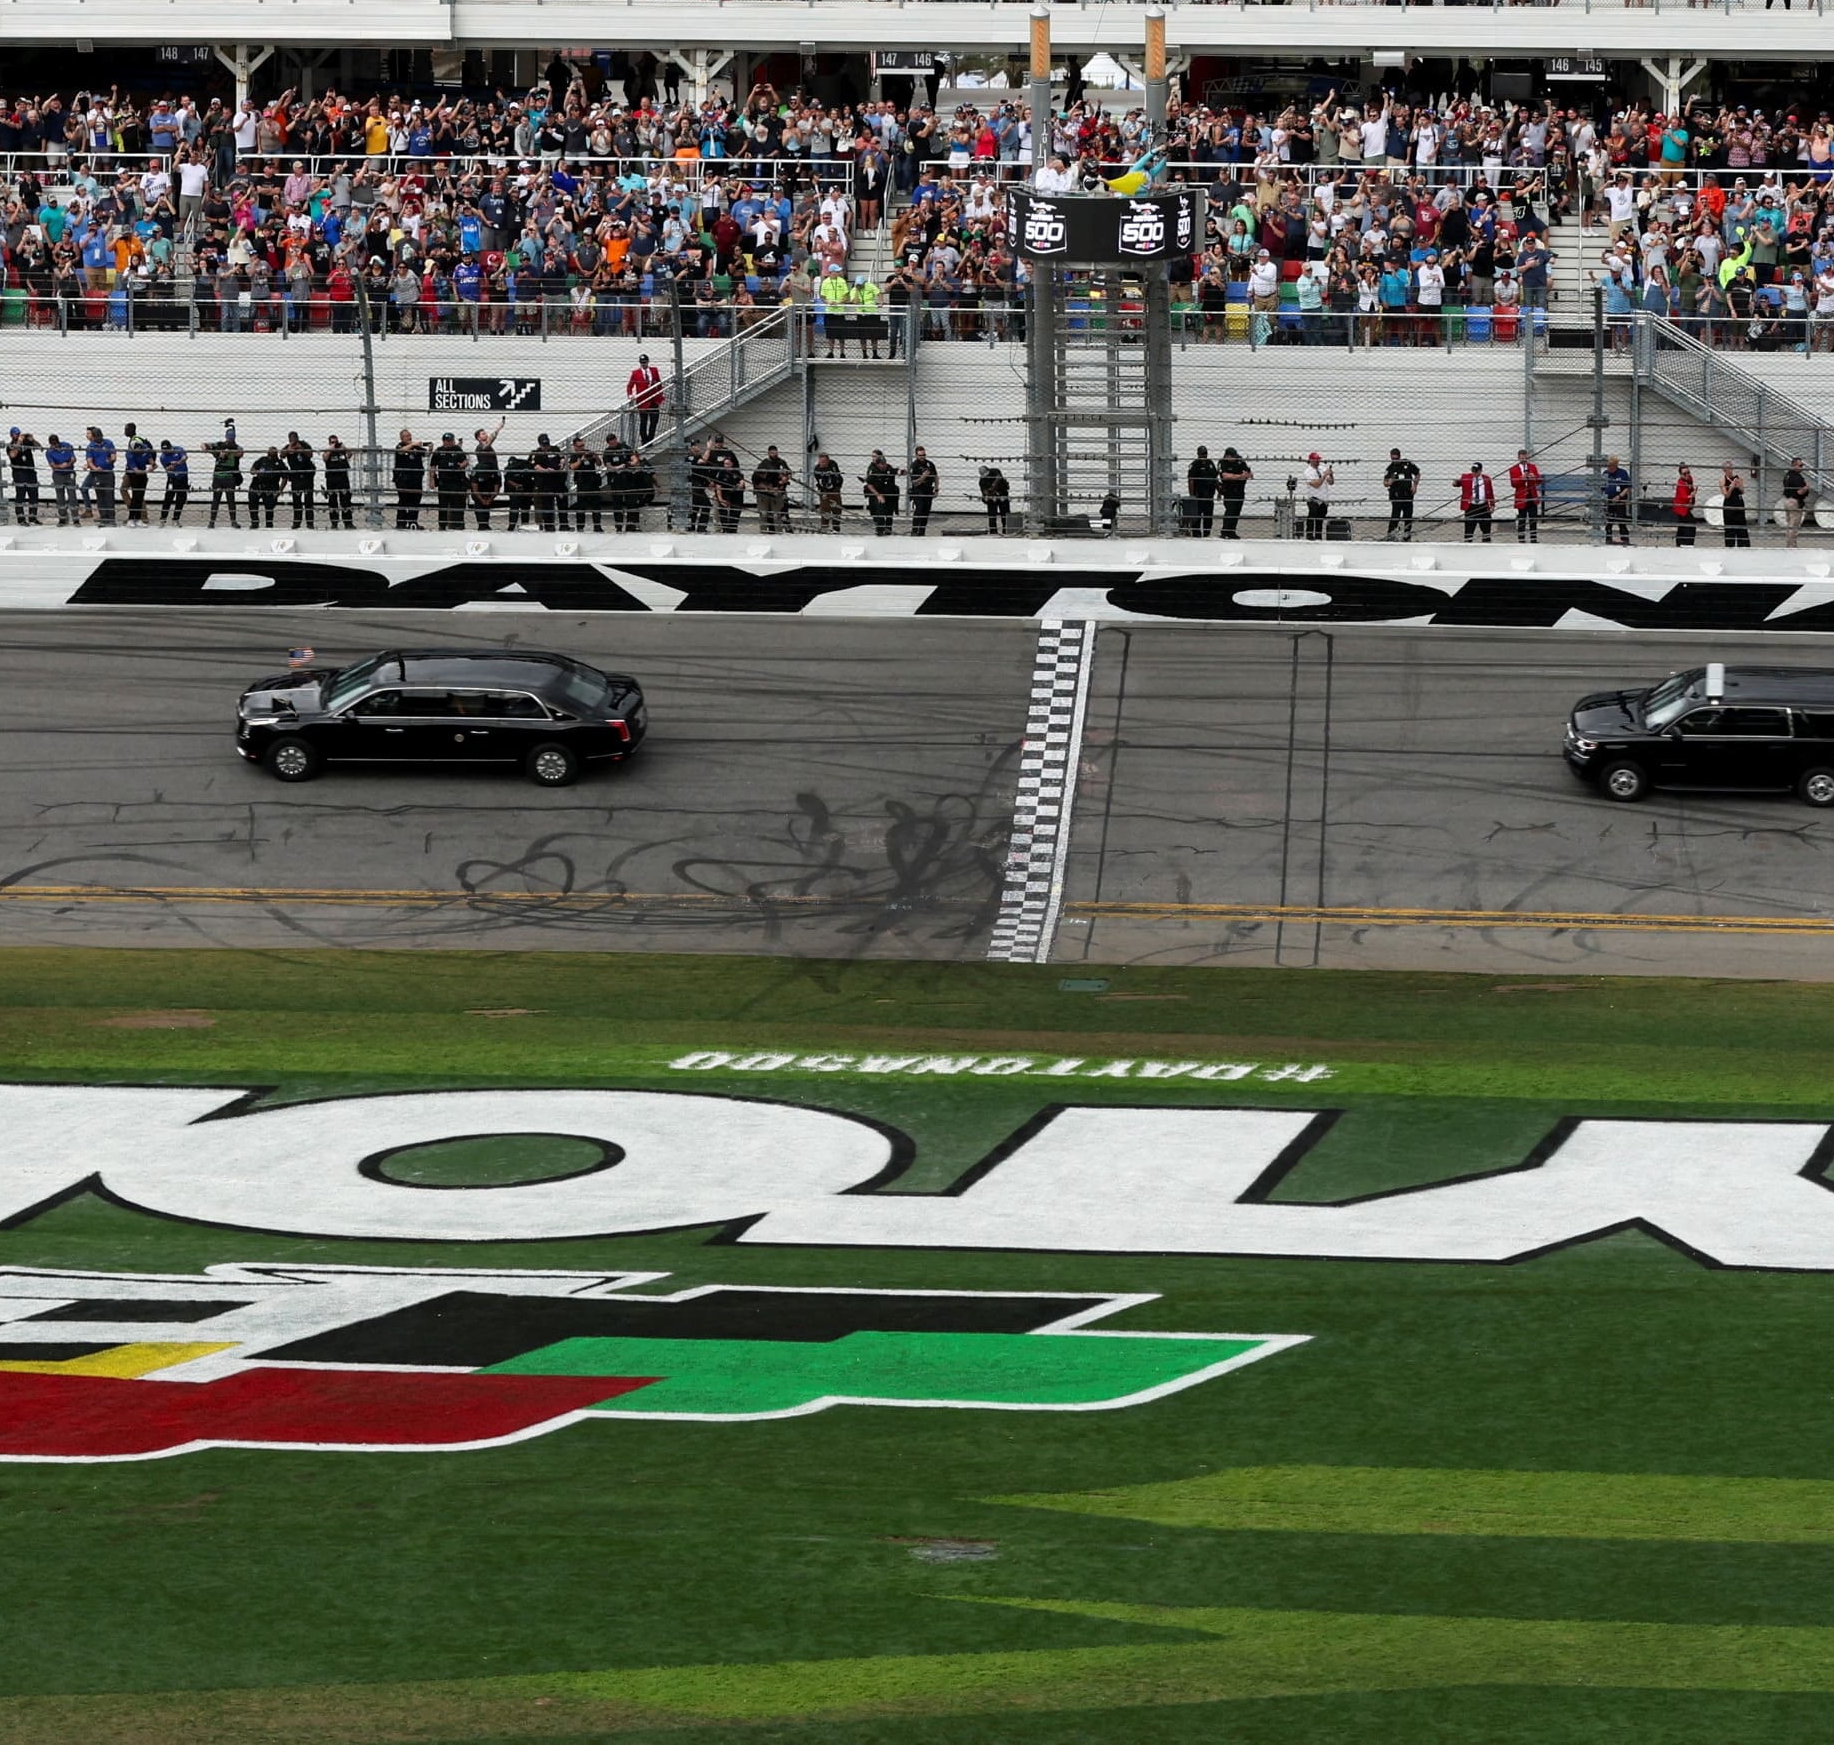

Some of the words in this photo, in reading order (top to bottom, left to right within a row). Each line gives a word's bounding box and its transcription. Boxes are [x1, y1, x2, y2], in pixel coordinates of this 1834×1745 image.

[161, 46, 178, 60] 148
[193, 46, 209, 60] 147
[881, 53, 897, 66] 147
[914, 53, 932, 66] 146
[1551, 58, 1569, 72] 146
[1585, 58, 1602, 72] 145
[1024, 221, 1064, 241] 500
[1122, 221, 1164, 242] 500
[435, 379, 456, 394] ALL
[435, 394, 491, 409] SECTIONS
[667, 1051, 1337, 1083] #DAYTONA500
